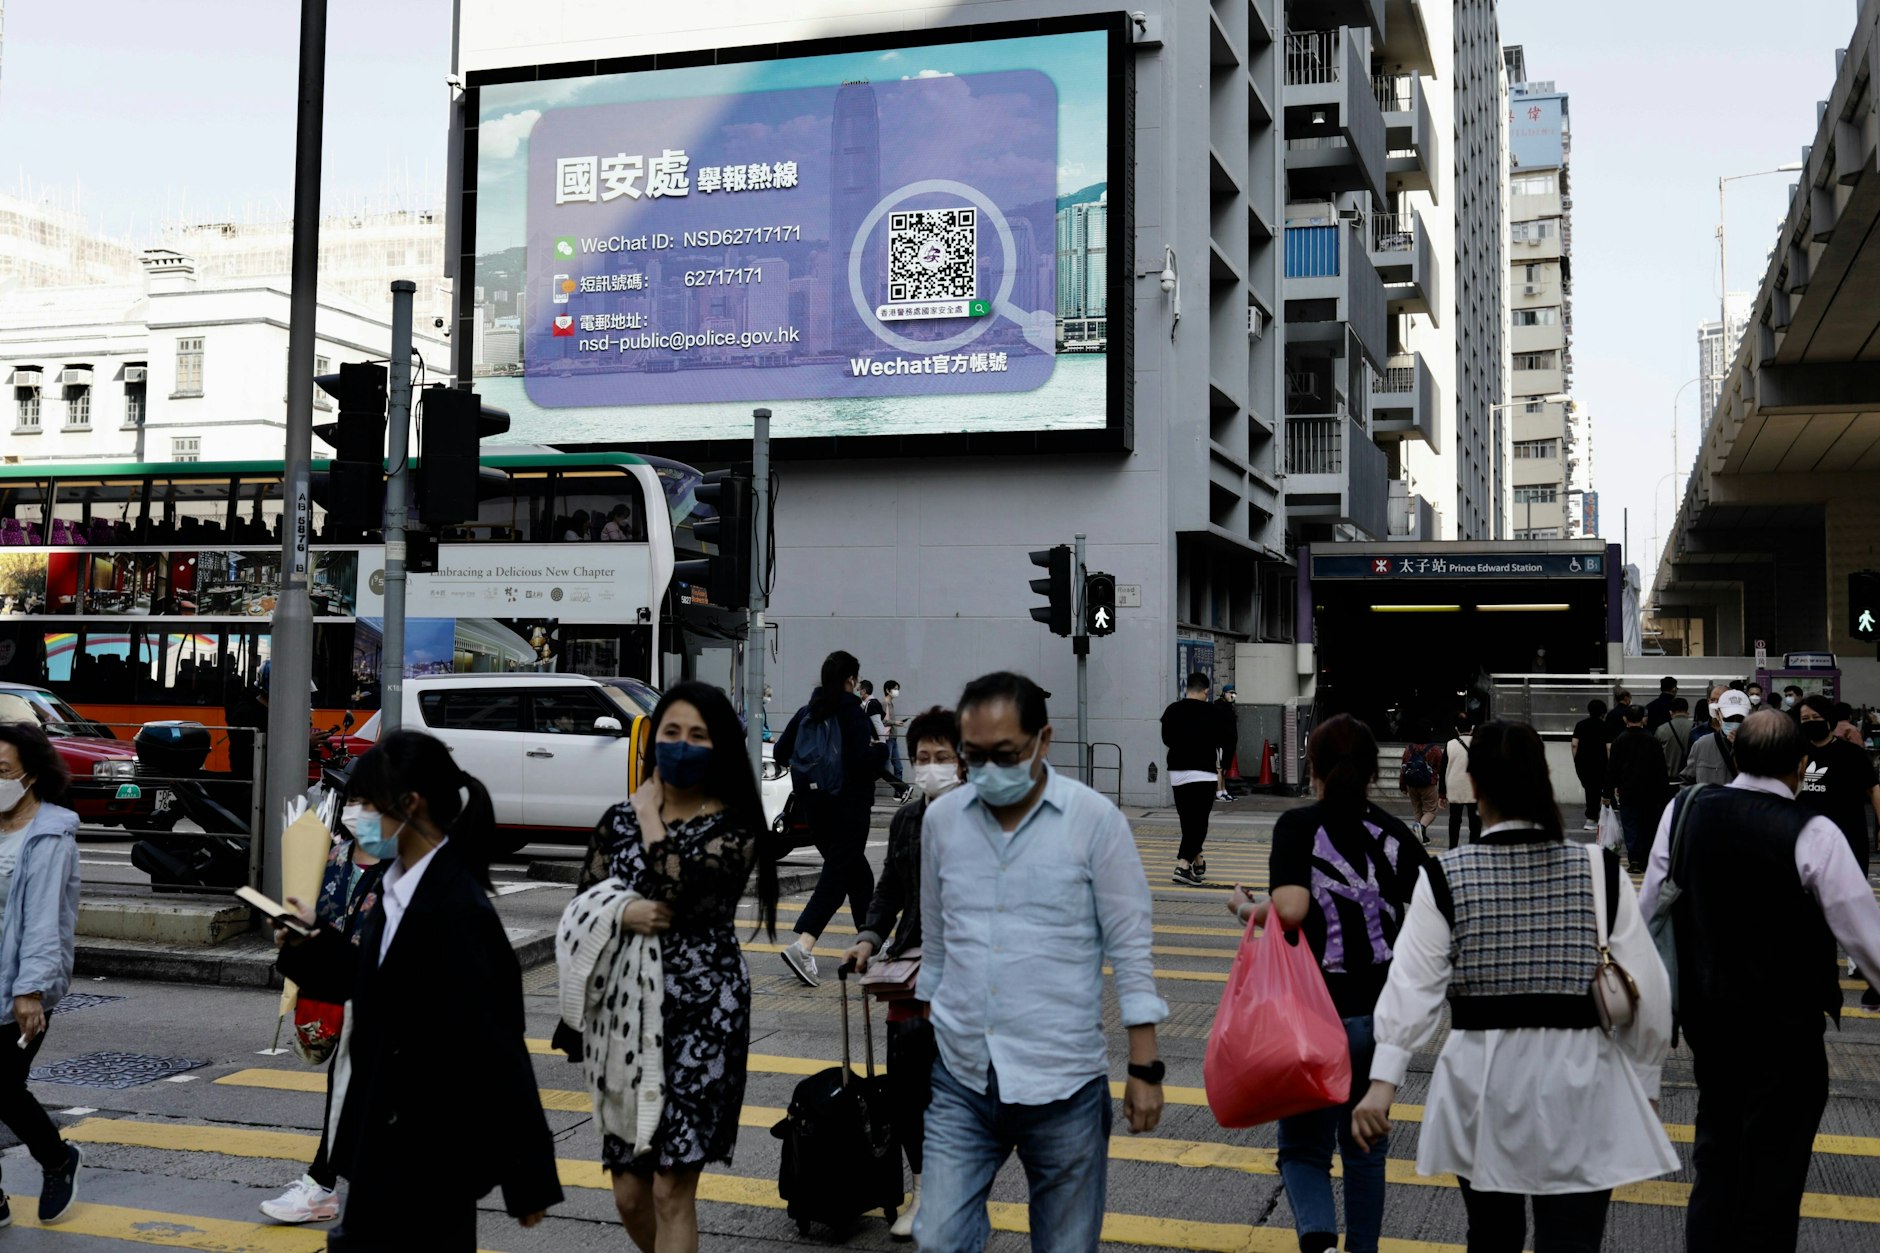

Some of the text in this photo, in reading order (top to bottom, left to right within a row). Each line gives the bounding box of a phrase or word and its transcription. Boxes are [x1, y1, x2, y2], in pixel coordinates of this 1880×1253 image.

[555, 149, 798, 205] 國安處 舉報熱線
[581, 225, 801, 253] WeChat ID: NSD62717171
[684, 267, 762, 287] 62717171
[880, 305, 963, 317] 香港警務處國家安全處
[579, 326, 800, 352] nsd-public@police.gov.hk
[850, 352, 1008, 376] Wechat官方帳號
[486, 569, 492, 577] a
[495, 567, 542, 577] Delicious
[546, 567, 569, 577] New
[573, 567, 616, 581] Chapter
[1399, 558, 1543, 573] 太子站 Prince Edward Station
